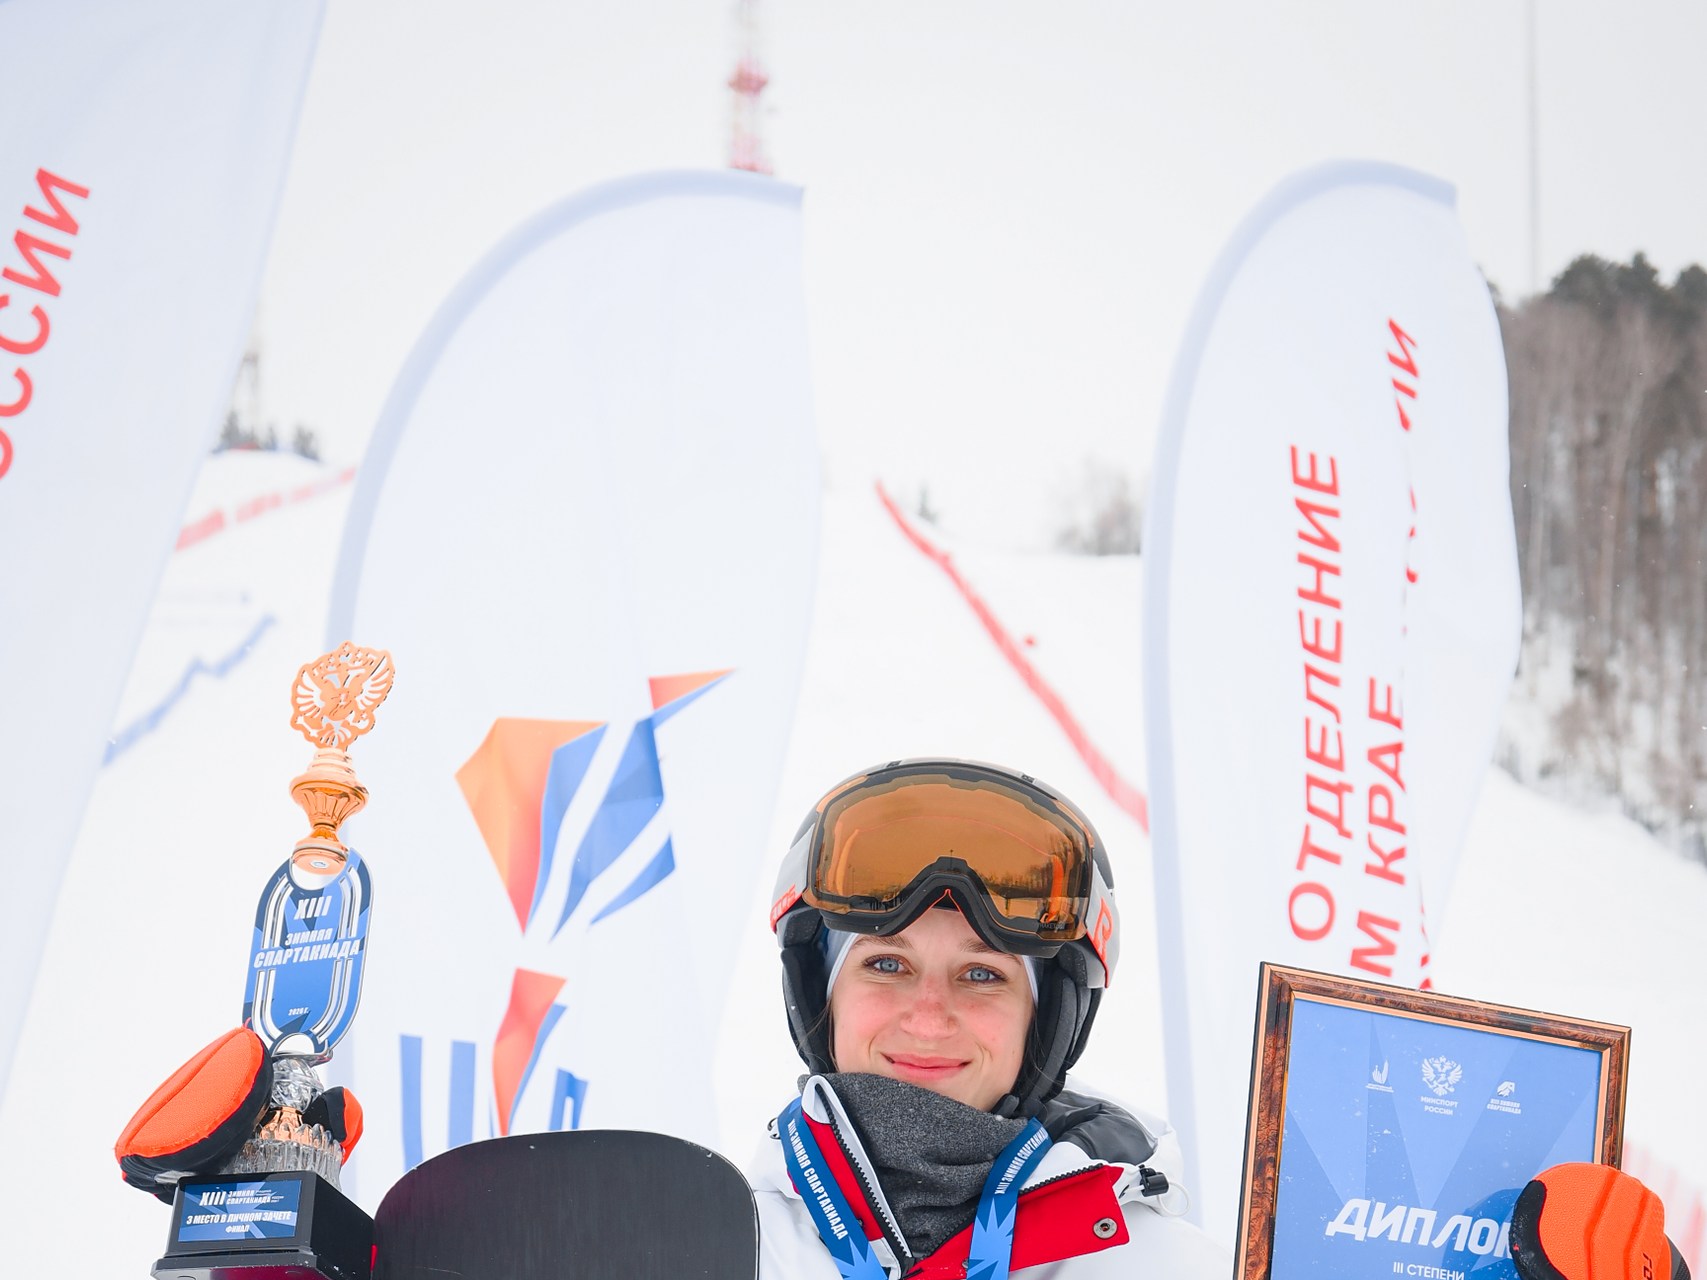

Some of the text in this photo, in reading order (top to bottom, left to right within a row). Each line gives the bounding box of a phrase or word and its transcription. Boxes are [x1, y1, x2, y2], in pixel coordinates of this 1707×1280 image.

[0, 167, 90, 480] ССИИ
[1287, 444, 1354, 942] ОТДЕЛЕНИЕ
[1365, 676, 1408, 887] КРАЕ
[293, 895, 332, 920] XIII
[285, 928, 333, 946] ЗИМНЯЯ
[253, 939, 361, 968] СПАРТАКИАДА
[1420, 1095, 1458, 1108] МИНСПОРТ
[1424, 1105, 1453, 1116] РОССИИ
[1001, 1156, 1026, 1182] ЗИМНЯЯ
[790, 1131, 812, 1169] ЗИМНЯЯ
[803, 1167, 849, 1240] СПАРТАКИАДА
[199, 1191, 227, 1206] XIII
[186, 1211, 292, 1225] 3 МЕСТО В ЛИЧНОМ ЗАЧЕТЕ
[225, 1224, 250, 1233] ФИНАЛ
[1393, 1261, 1404, 1273] III
